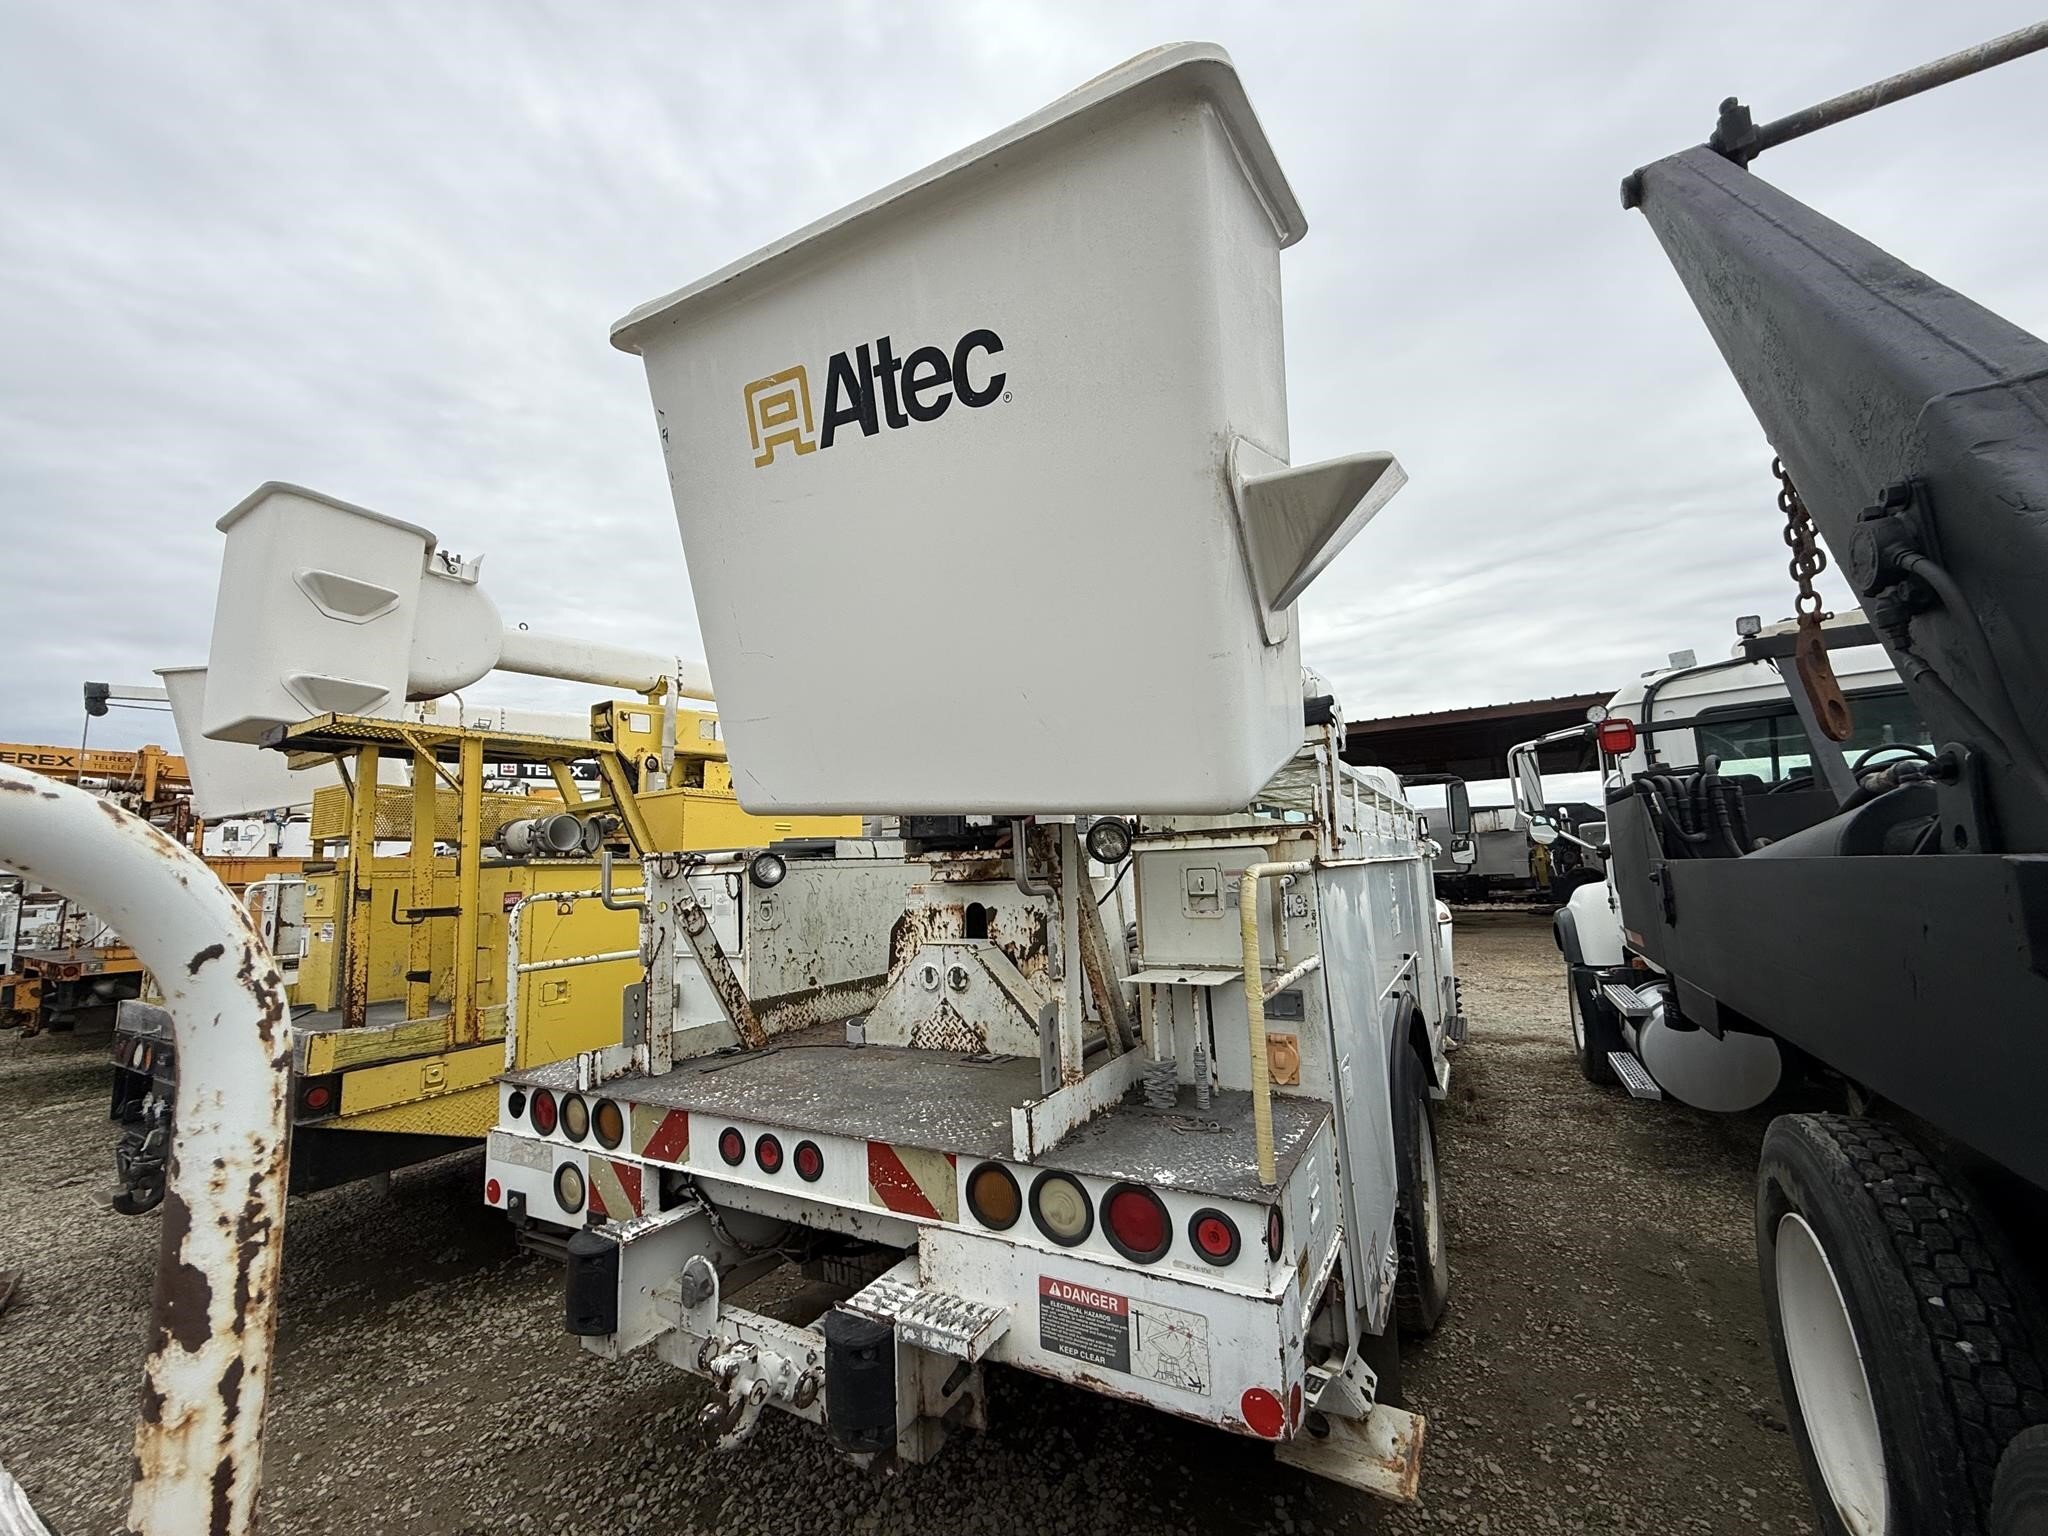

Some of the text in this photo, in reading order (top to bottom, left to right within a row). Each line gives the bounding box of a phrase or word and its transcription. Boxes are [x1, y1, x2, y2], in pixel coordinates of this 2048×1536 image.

[820, 329, 1006, 449] Altec
[1063, 1282, 1118, 1312] DANGER
[1050, 1300, 1111, 1322] ELECTRICAL HAZARDS
[1059, 1344, 1106, 1364] KEEP CLEAR
